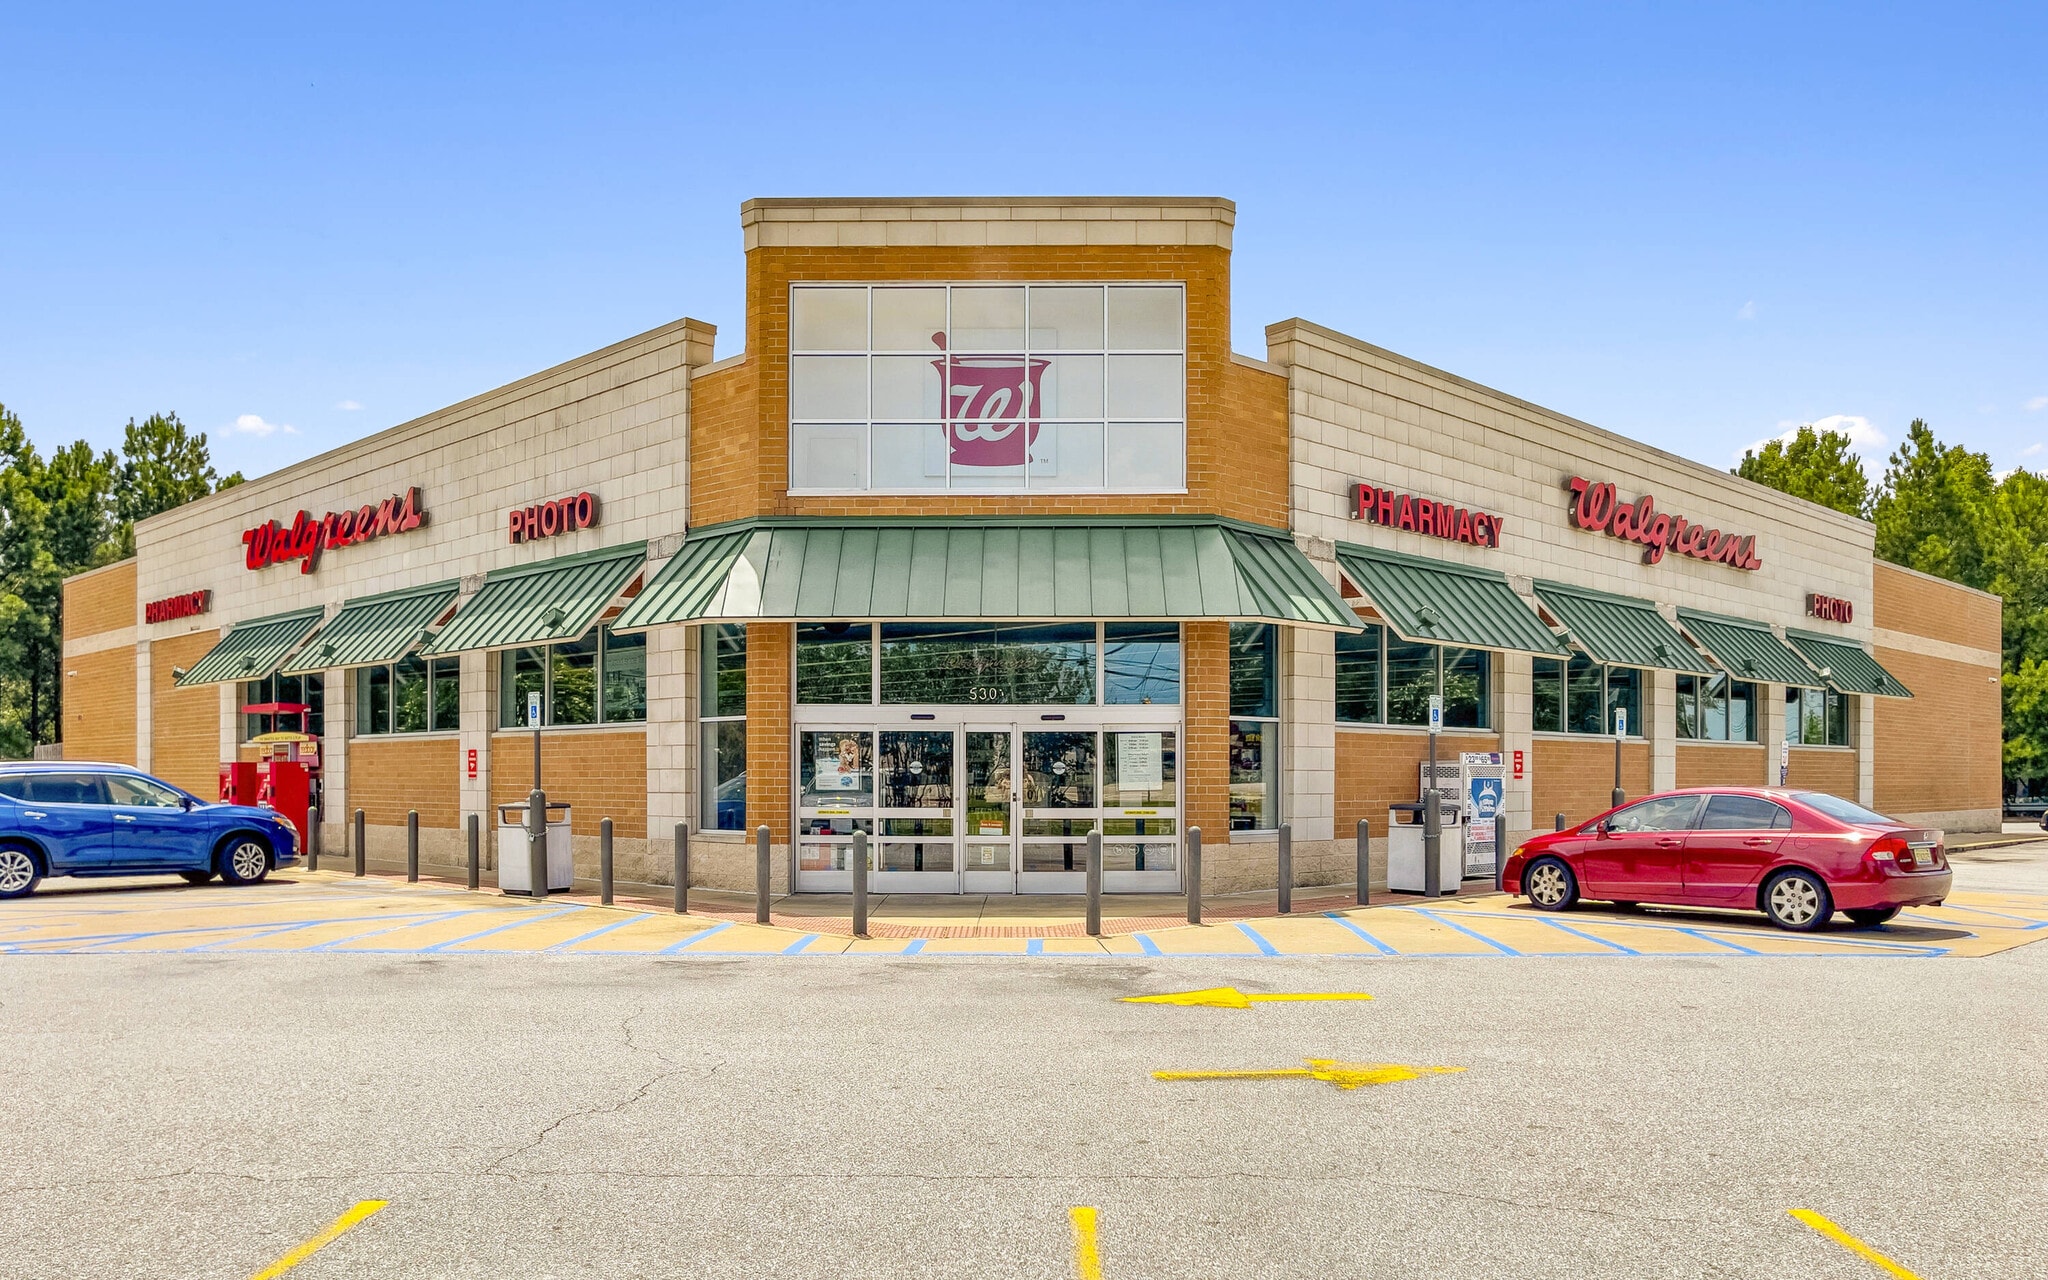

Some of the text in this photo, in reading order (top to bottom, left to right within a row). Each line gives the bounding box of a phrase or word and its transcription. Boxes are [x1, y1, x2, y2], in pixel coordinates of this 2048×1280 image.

[242, 486, 426, 575] Walgreens
[509, 491, 597, 544] PHOTO
[1355, 483, 1503, 548] PHARMACY
[1569, 475, 1762, 570] Walgreens
[145, 590, 207, 624] PHARMACY
[1812, 593, 1853, 624] PHOTO
